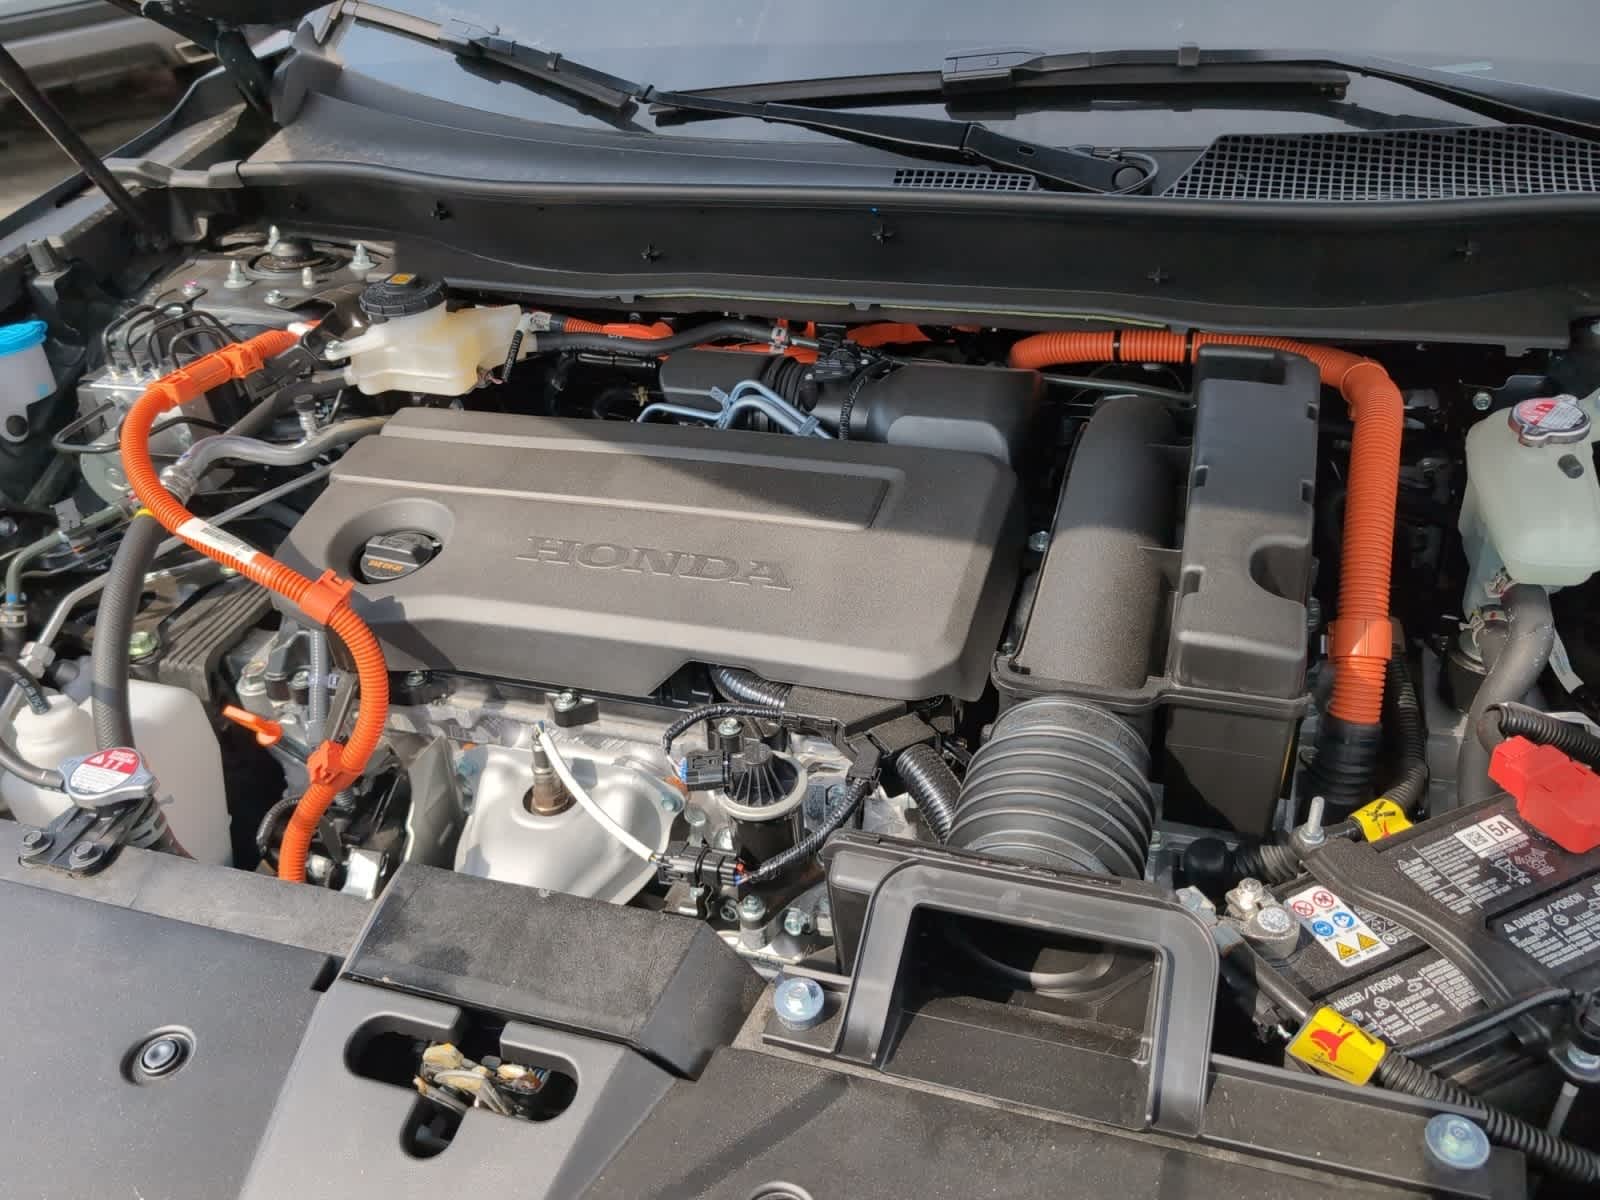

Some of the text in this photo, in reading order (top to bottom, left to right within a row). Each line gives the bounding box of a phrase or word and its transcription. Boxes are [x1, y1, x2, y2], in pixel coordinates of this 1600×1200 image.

[514, 536, 792, 591] HONDA
[1487, 820, 1515, 837] 5A
[1512, 908, 1550, 929] DANGER
[1551, 892, 1585, 911] POISON
[1333, 991, 1365, 1012] ANGER
[1368, 973, 1405, 996] POISON
